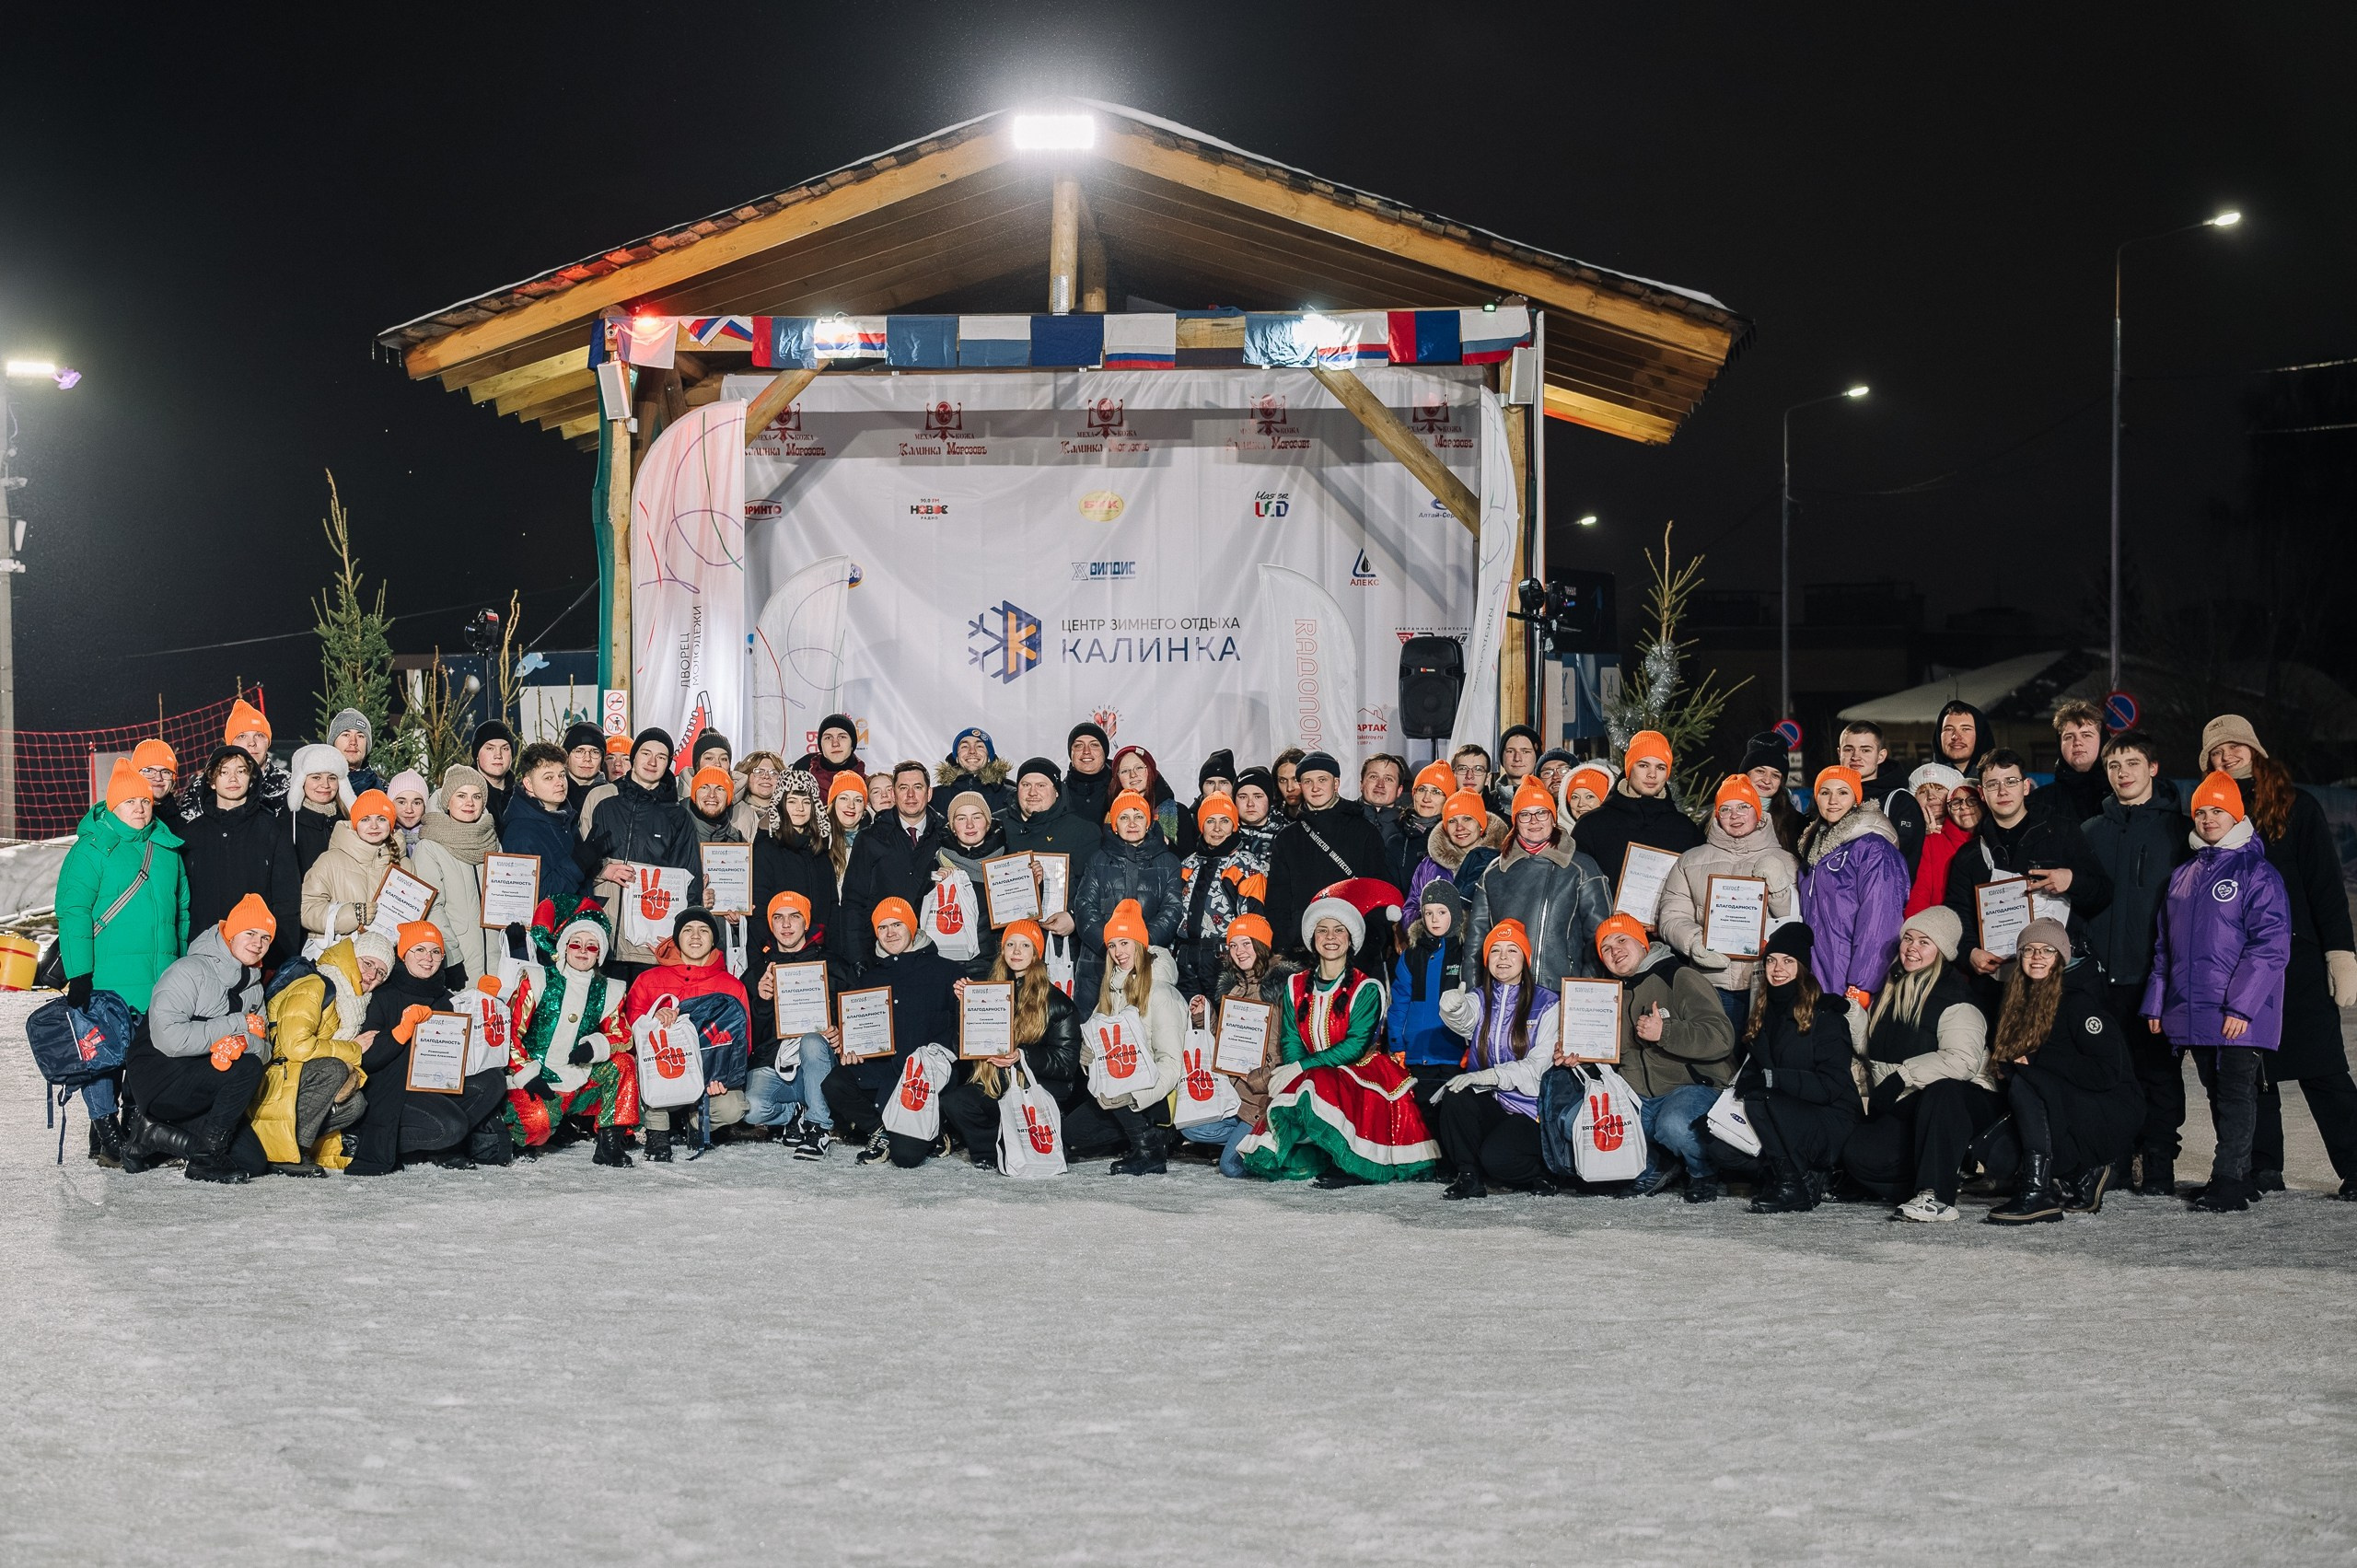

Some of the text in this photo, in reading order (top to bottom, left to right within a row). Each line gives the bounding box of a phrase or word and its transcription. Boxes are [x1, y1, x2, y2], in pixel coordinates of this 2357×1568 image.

[898, 442, 941, 456] Калинка
[1350, 578, 1379, 586] АЛЕКС
[1062, 617, 1240, 633] ЦЕНТР ЗИМНЕГО ОТДЫХА
[692, 605, 702, 686] МОЛОДЕЖИ
[1062, 636, 1241, 663] КАЛИНКА
[680, 633, 690, 688] ДВОРЕЦ
[1329, 850, 1352, 876] UNAFFECTED
[1985, 905, 2026, 916] БЛАГОДАРНОСТЬ
[1114, 1050, 1142, 1058] МОЛОДА
